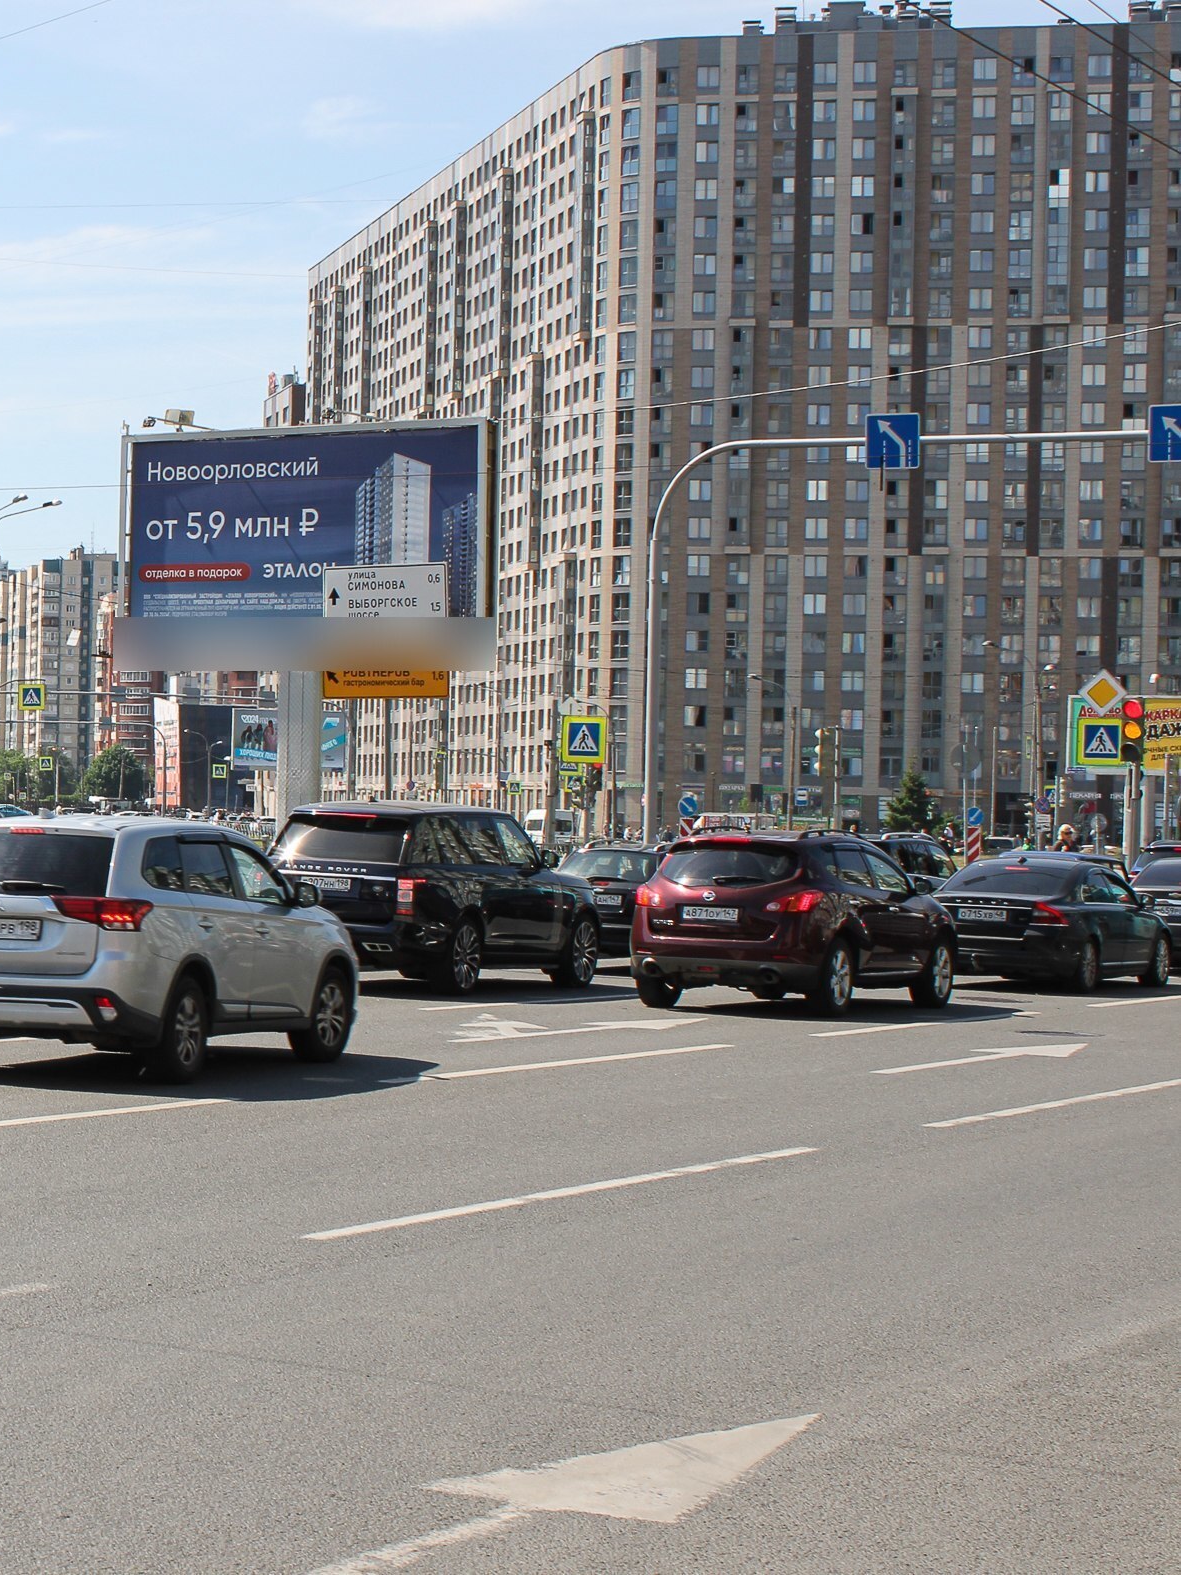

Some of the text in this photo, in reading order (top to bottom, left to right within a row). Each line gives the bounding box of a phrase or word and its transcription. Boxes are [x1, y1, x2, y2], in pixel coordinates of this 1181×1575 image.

[147, 457, 319, 484] Новоорловский
[146, 519, 178, 541] от
[186, 510, 226, 544] 5,9
[234, 515, 289, 539] млн
[145, 566, 243, 580] отделка в подарок
[263, 562, 335, 579] ЭТАЛО
[347, 571, 376, 581] улица
[347, 580, 406, 592] СИМОНОВА
[348, 597, 418, 609] ВЫБОРГСКОЕ
[343, 677, 425, 688] гастрономический бар
[327, 866, 368, 874] ROVER
[17, 920, 37, 932] 198
